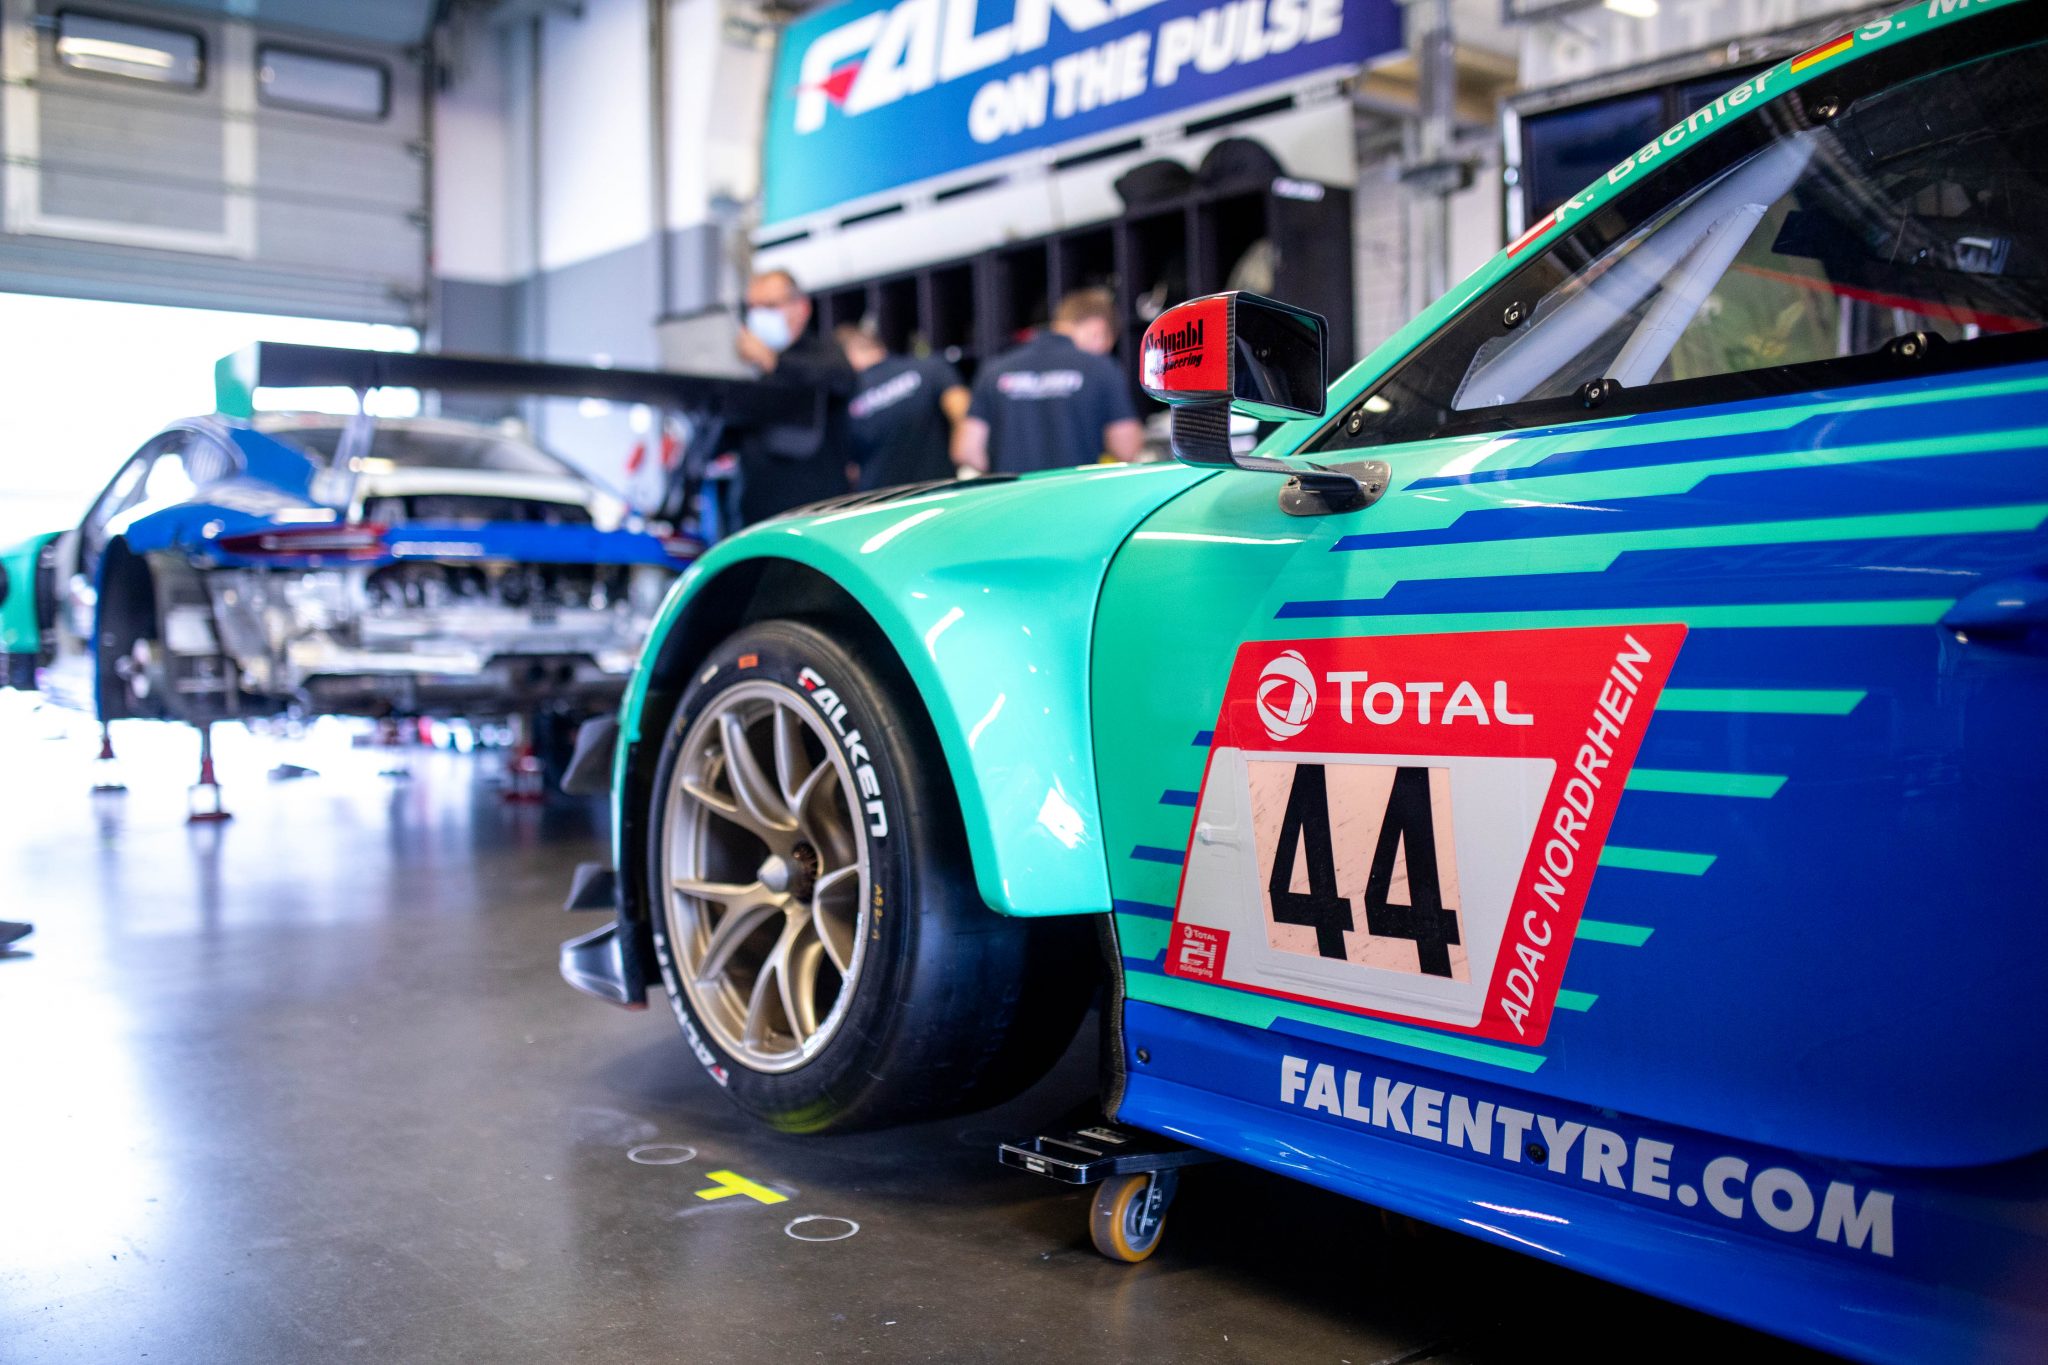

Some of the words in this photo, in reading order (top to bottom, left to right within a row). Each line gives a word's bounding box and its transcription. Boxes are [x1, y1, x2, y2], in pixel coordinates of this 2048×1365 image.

[967, 64, 1050, 144] ON
[1050, 30, 1152, 120] THE
[1153, 0, 1345, 88] PULSE
[1270, 763, 1461, 979] 44
[1500, 909, 1553, 1037] ADAC
[1533, 633, 1652, 913] NORDRHEIN
[1280, 1055, 1895, 1258] FALKENTYRE.COM
